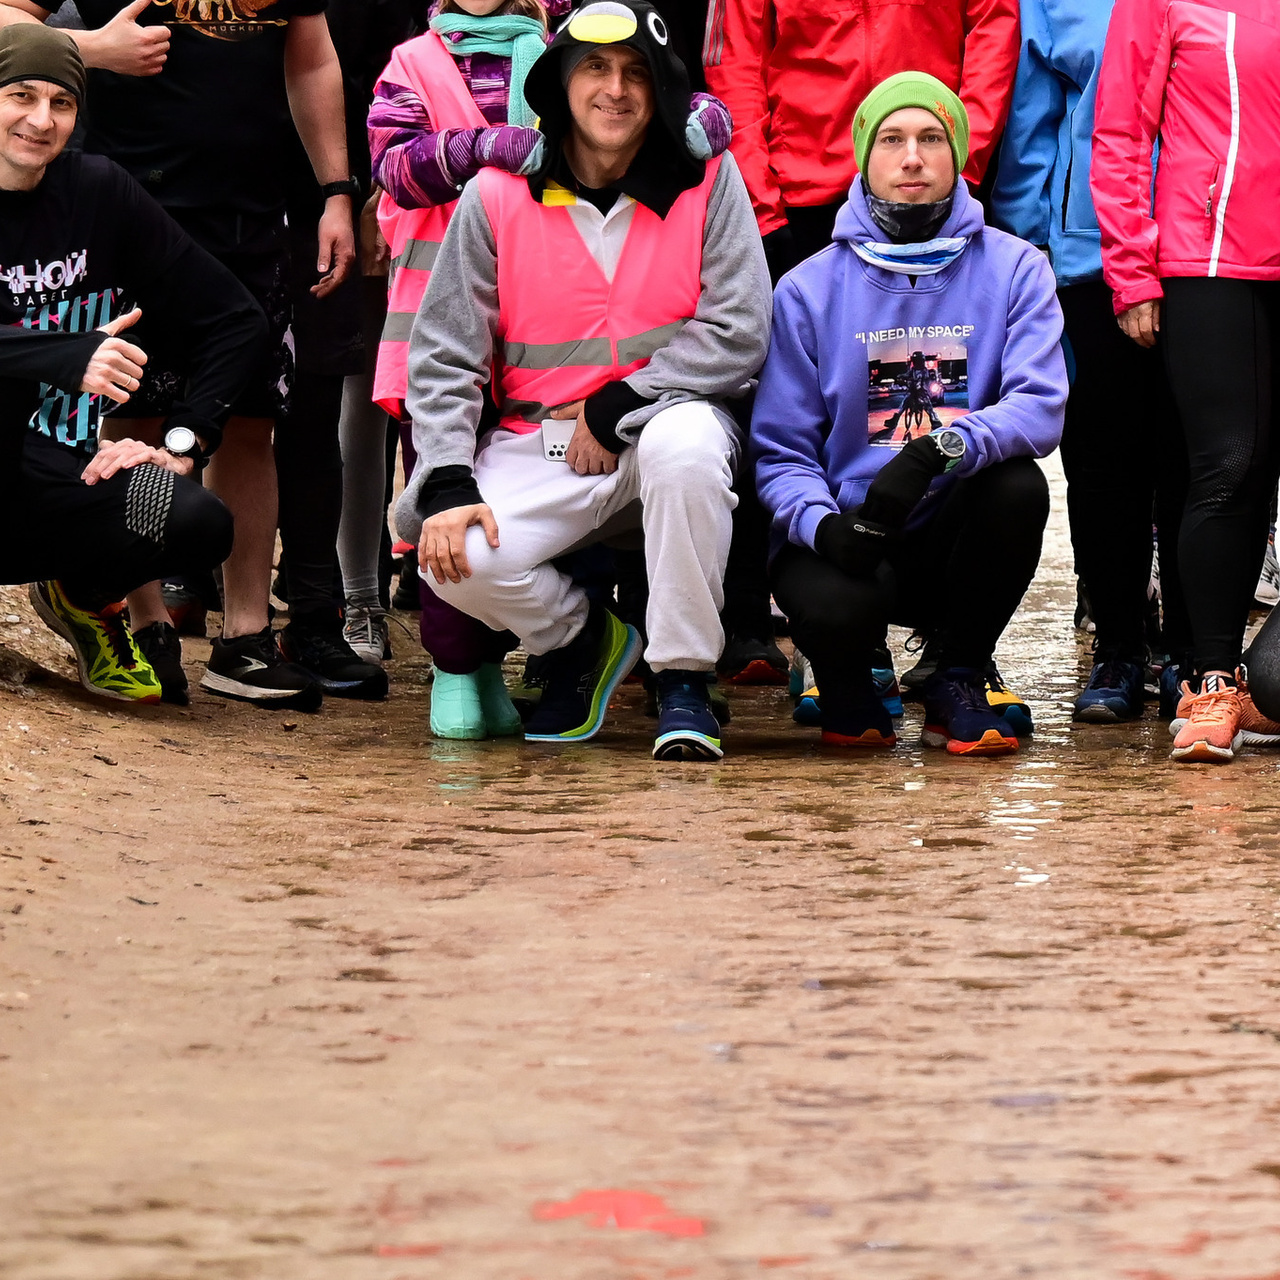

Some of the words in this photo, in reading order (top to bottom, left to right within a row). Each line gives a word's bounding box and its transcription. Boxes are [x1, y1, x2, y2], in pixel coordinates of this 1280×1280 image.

[13, 289, 68, 306] ЗАБЕГ
[869, 328, 906, 343] NEED
[908, 326, 926, 338] MY
